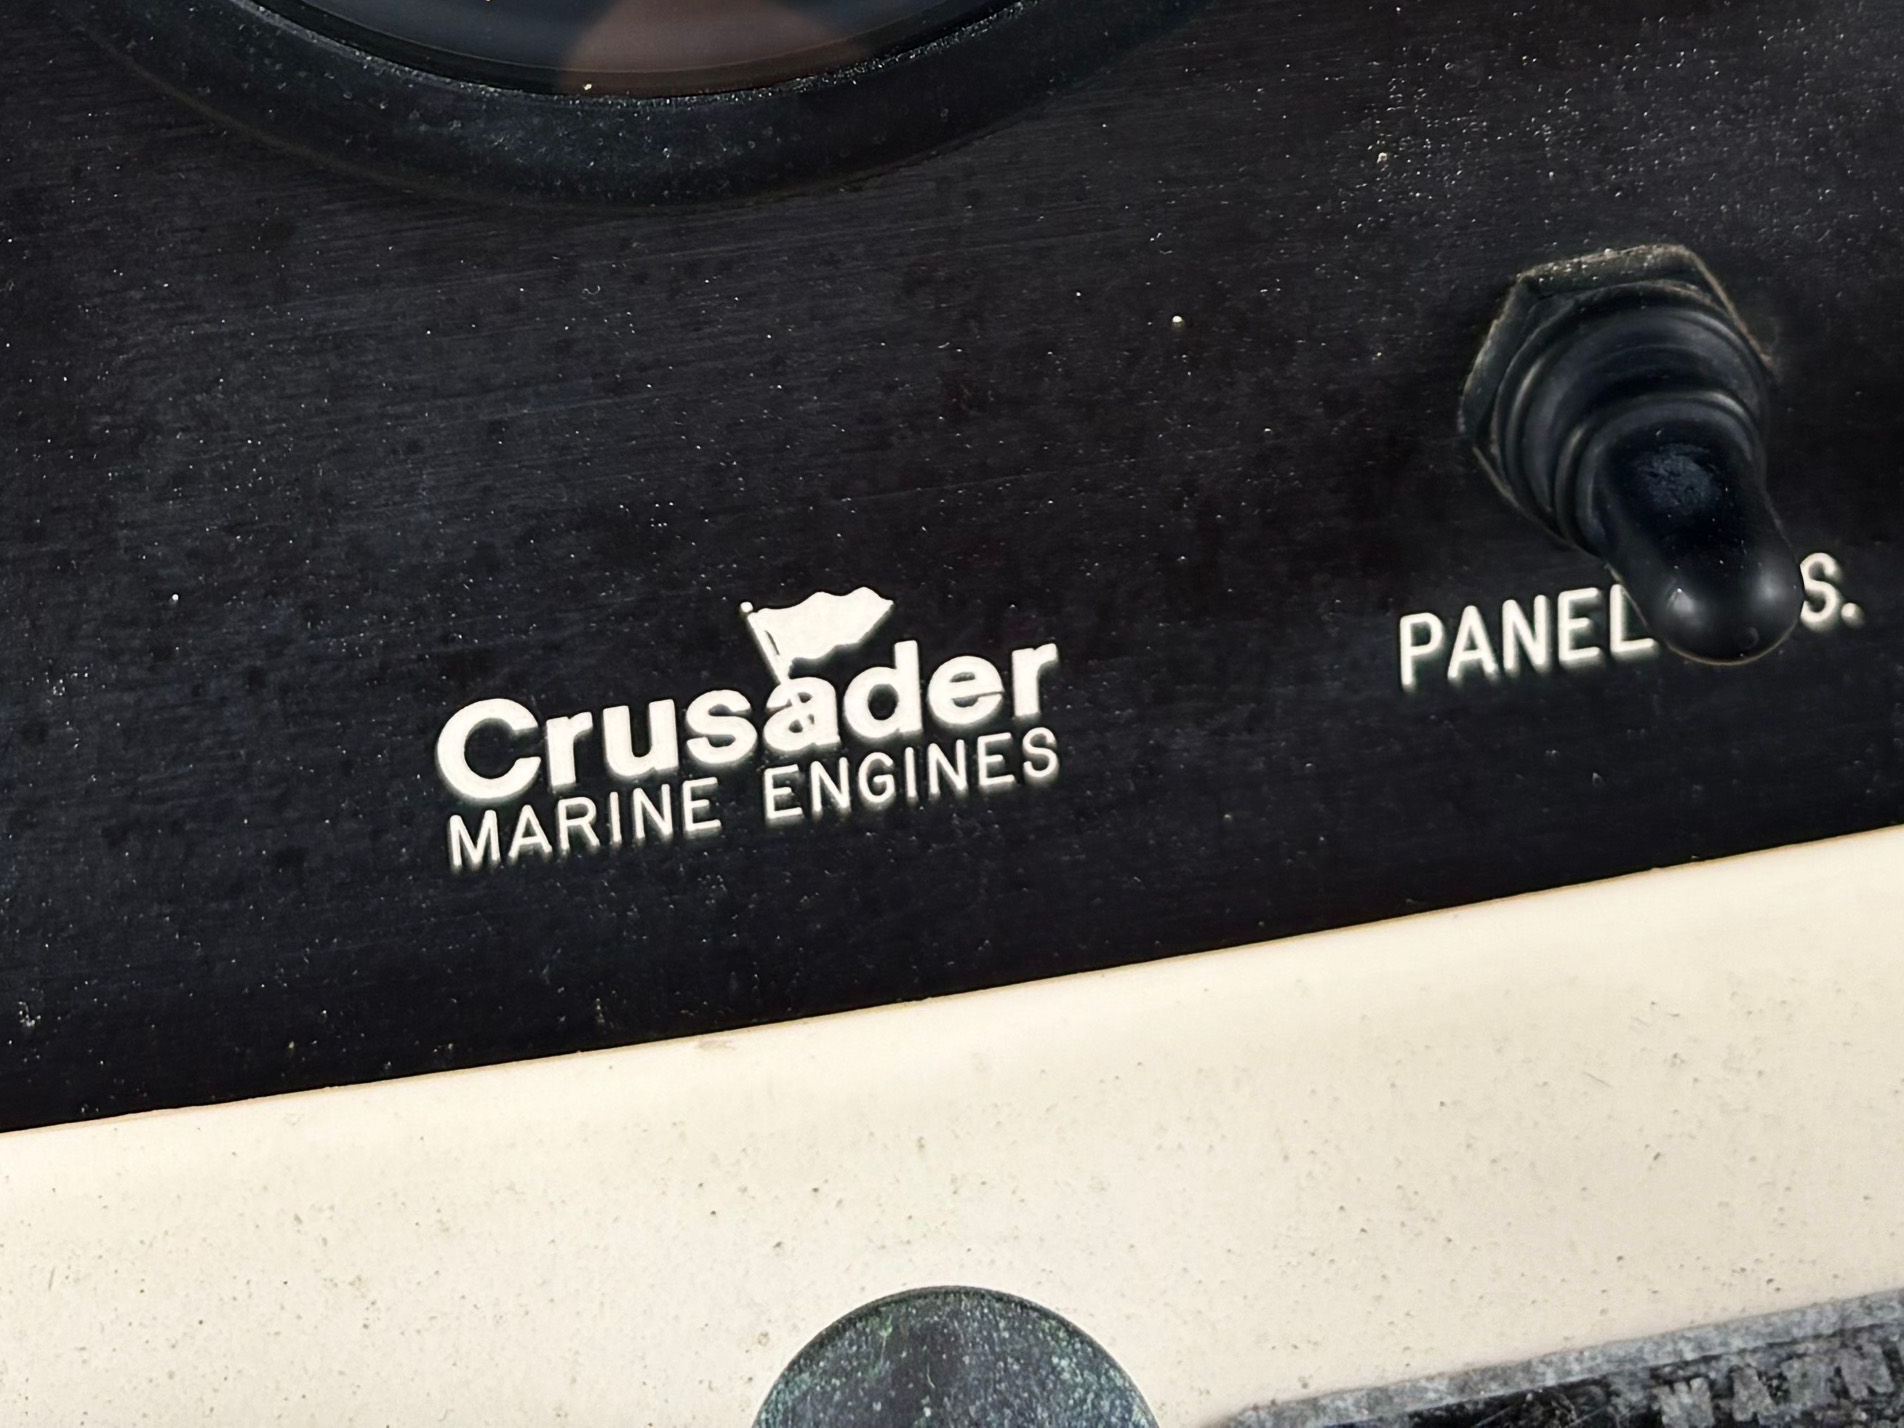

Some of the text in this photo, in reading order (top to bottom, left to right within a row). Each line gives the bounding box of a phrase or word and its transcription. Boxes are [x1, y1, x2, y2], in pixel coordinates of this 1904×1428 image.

[1400, 584, 1655, 687] PANEL
[436, 640, 1059, 801] Crusader
[446, 727, 1060, 871] MARINE ENGINES
